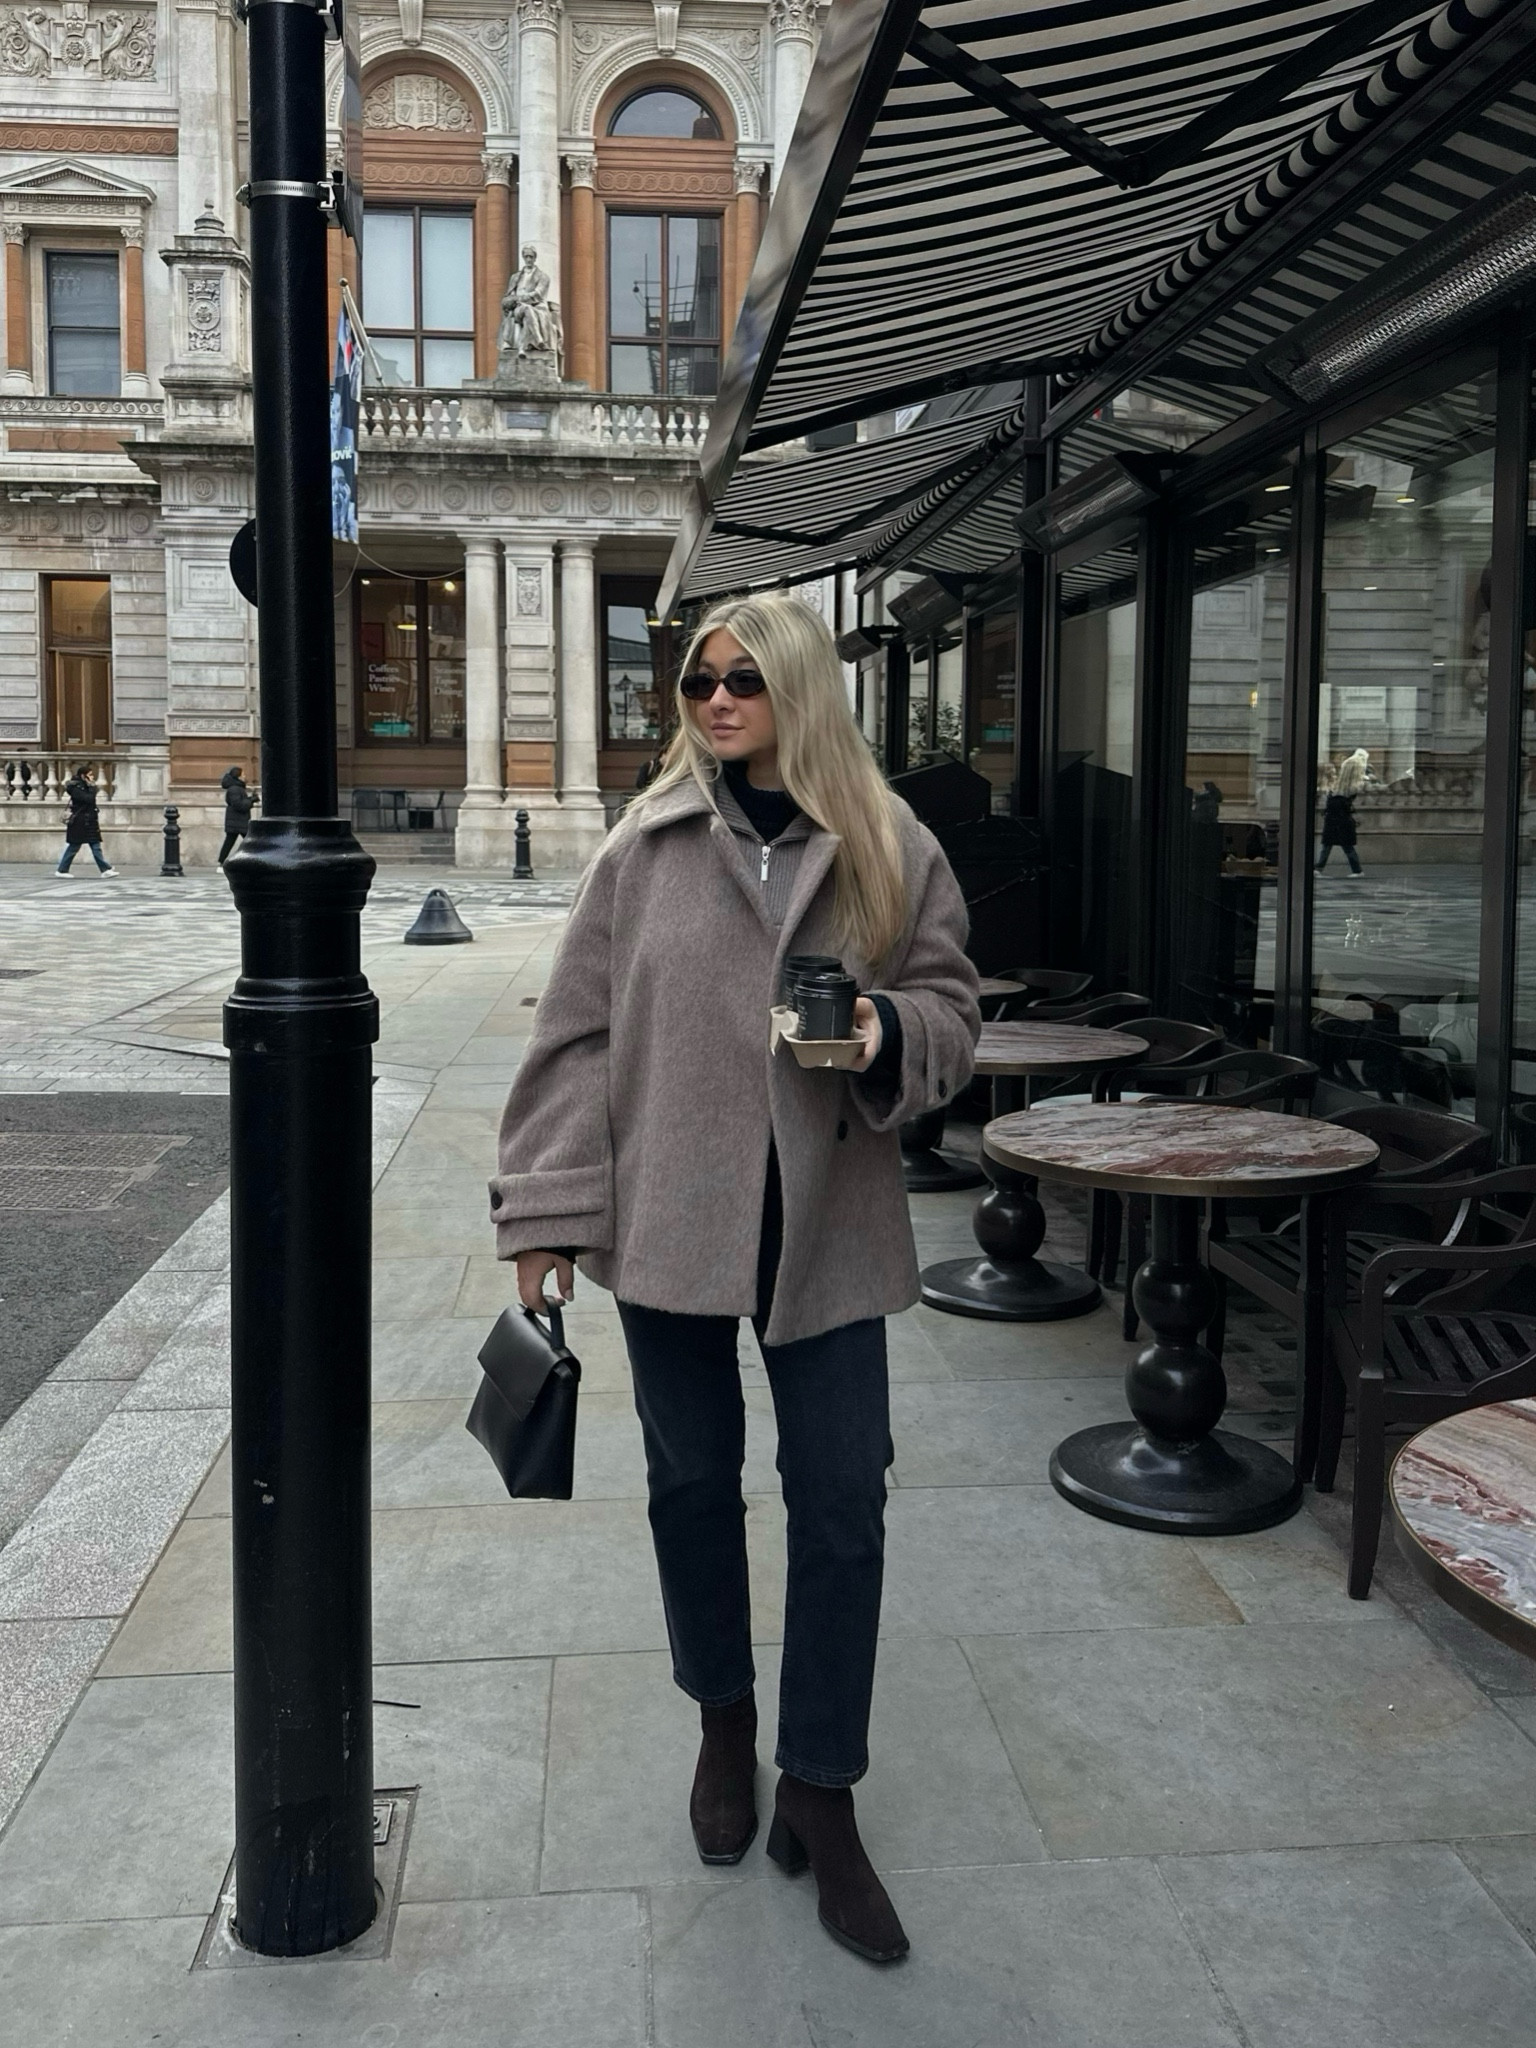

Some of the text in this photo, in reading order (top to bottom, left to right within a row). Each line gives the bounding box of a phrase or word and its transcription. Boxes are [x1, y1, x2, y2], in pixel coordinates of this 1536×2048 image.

[368, 664, 399, 673] Coffees
[368, 674, 401, 683] Pastries
[368, 683, 396, 692] Wines
